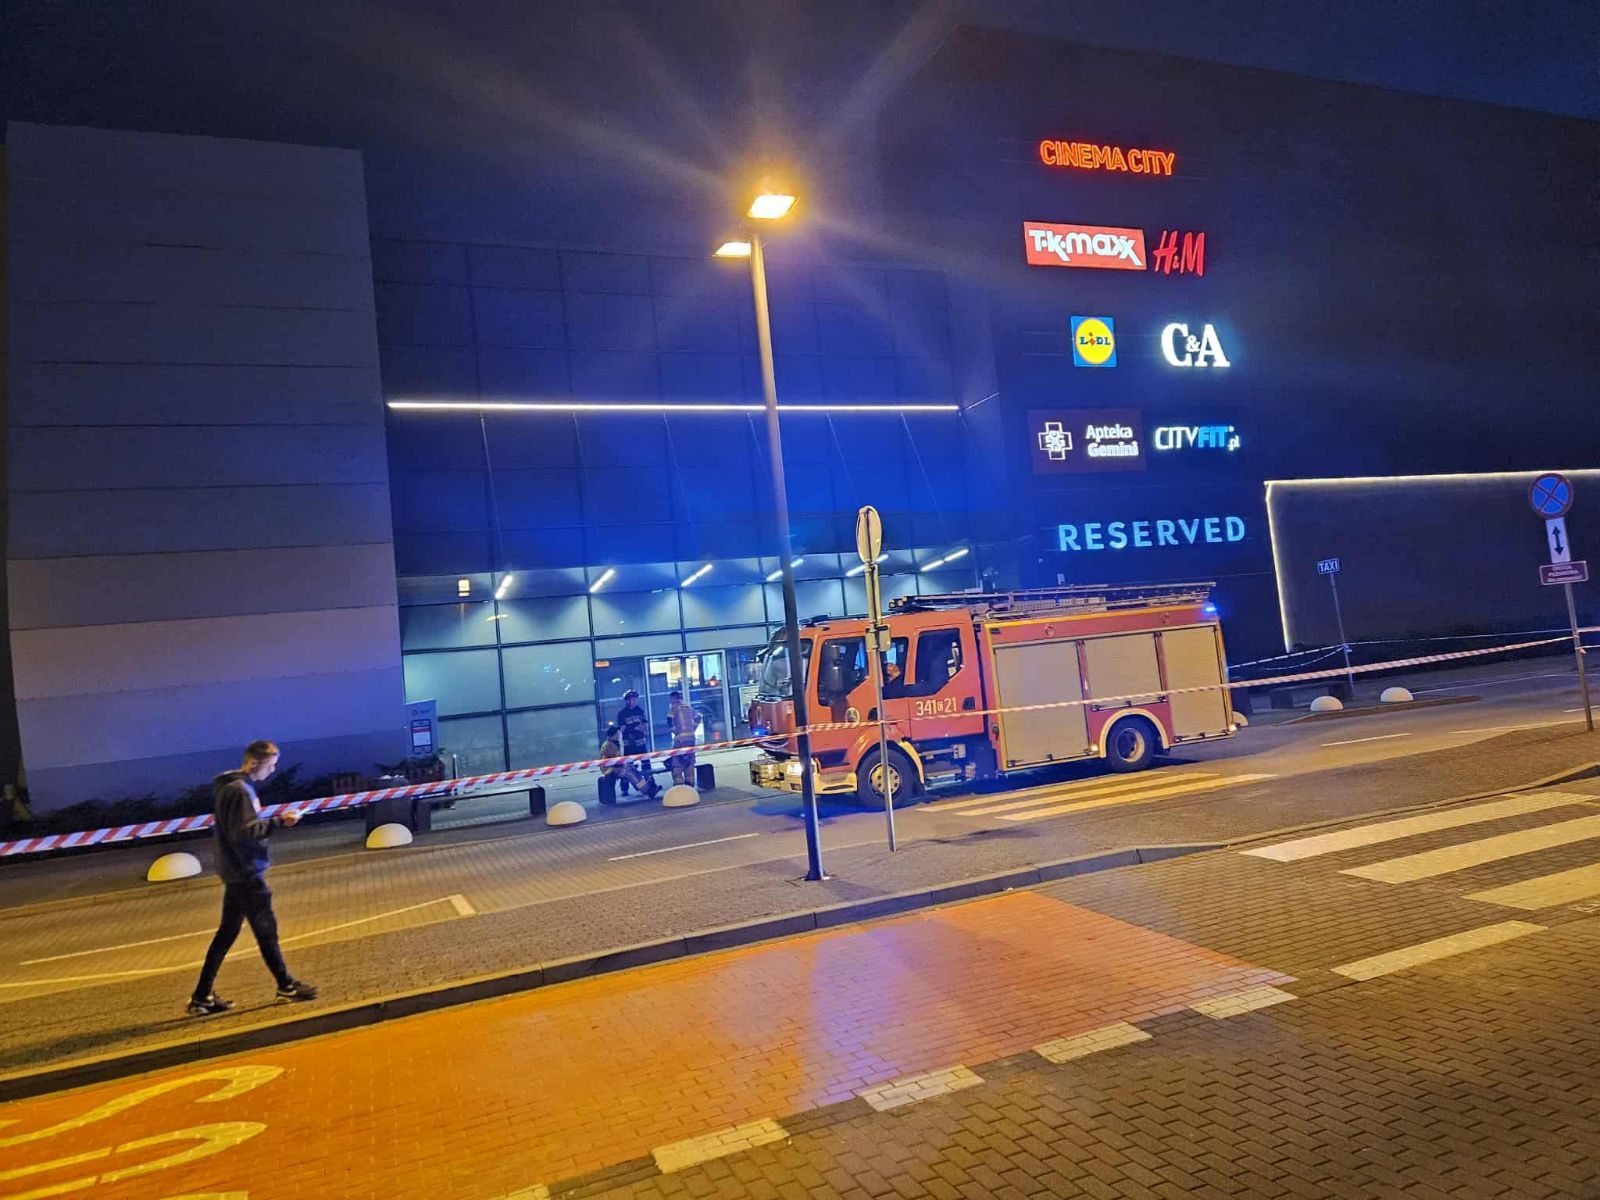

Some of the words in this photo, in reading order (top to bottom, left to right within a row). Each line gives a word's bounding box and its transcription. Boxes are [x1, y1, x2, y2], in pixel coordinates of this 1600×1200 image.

[1040, 140, 1128, 172] CINEMA
[1129, 149, 1176, 176] CITY
[1152, 230, 1205, 277] H&M
[1161, 322, 1231, 368] C&A
[1085, 423, 1134, 443] Apteka
[1087, 440, 1140, 458] Gemini
[1058, 516, 1246, 552] RESERVED
[1319, 560, 1338, 572] TAXI
